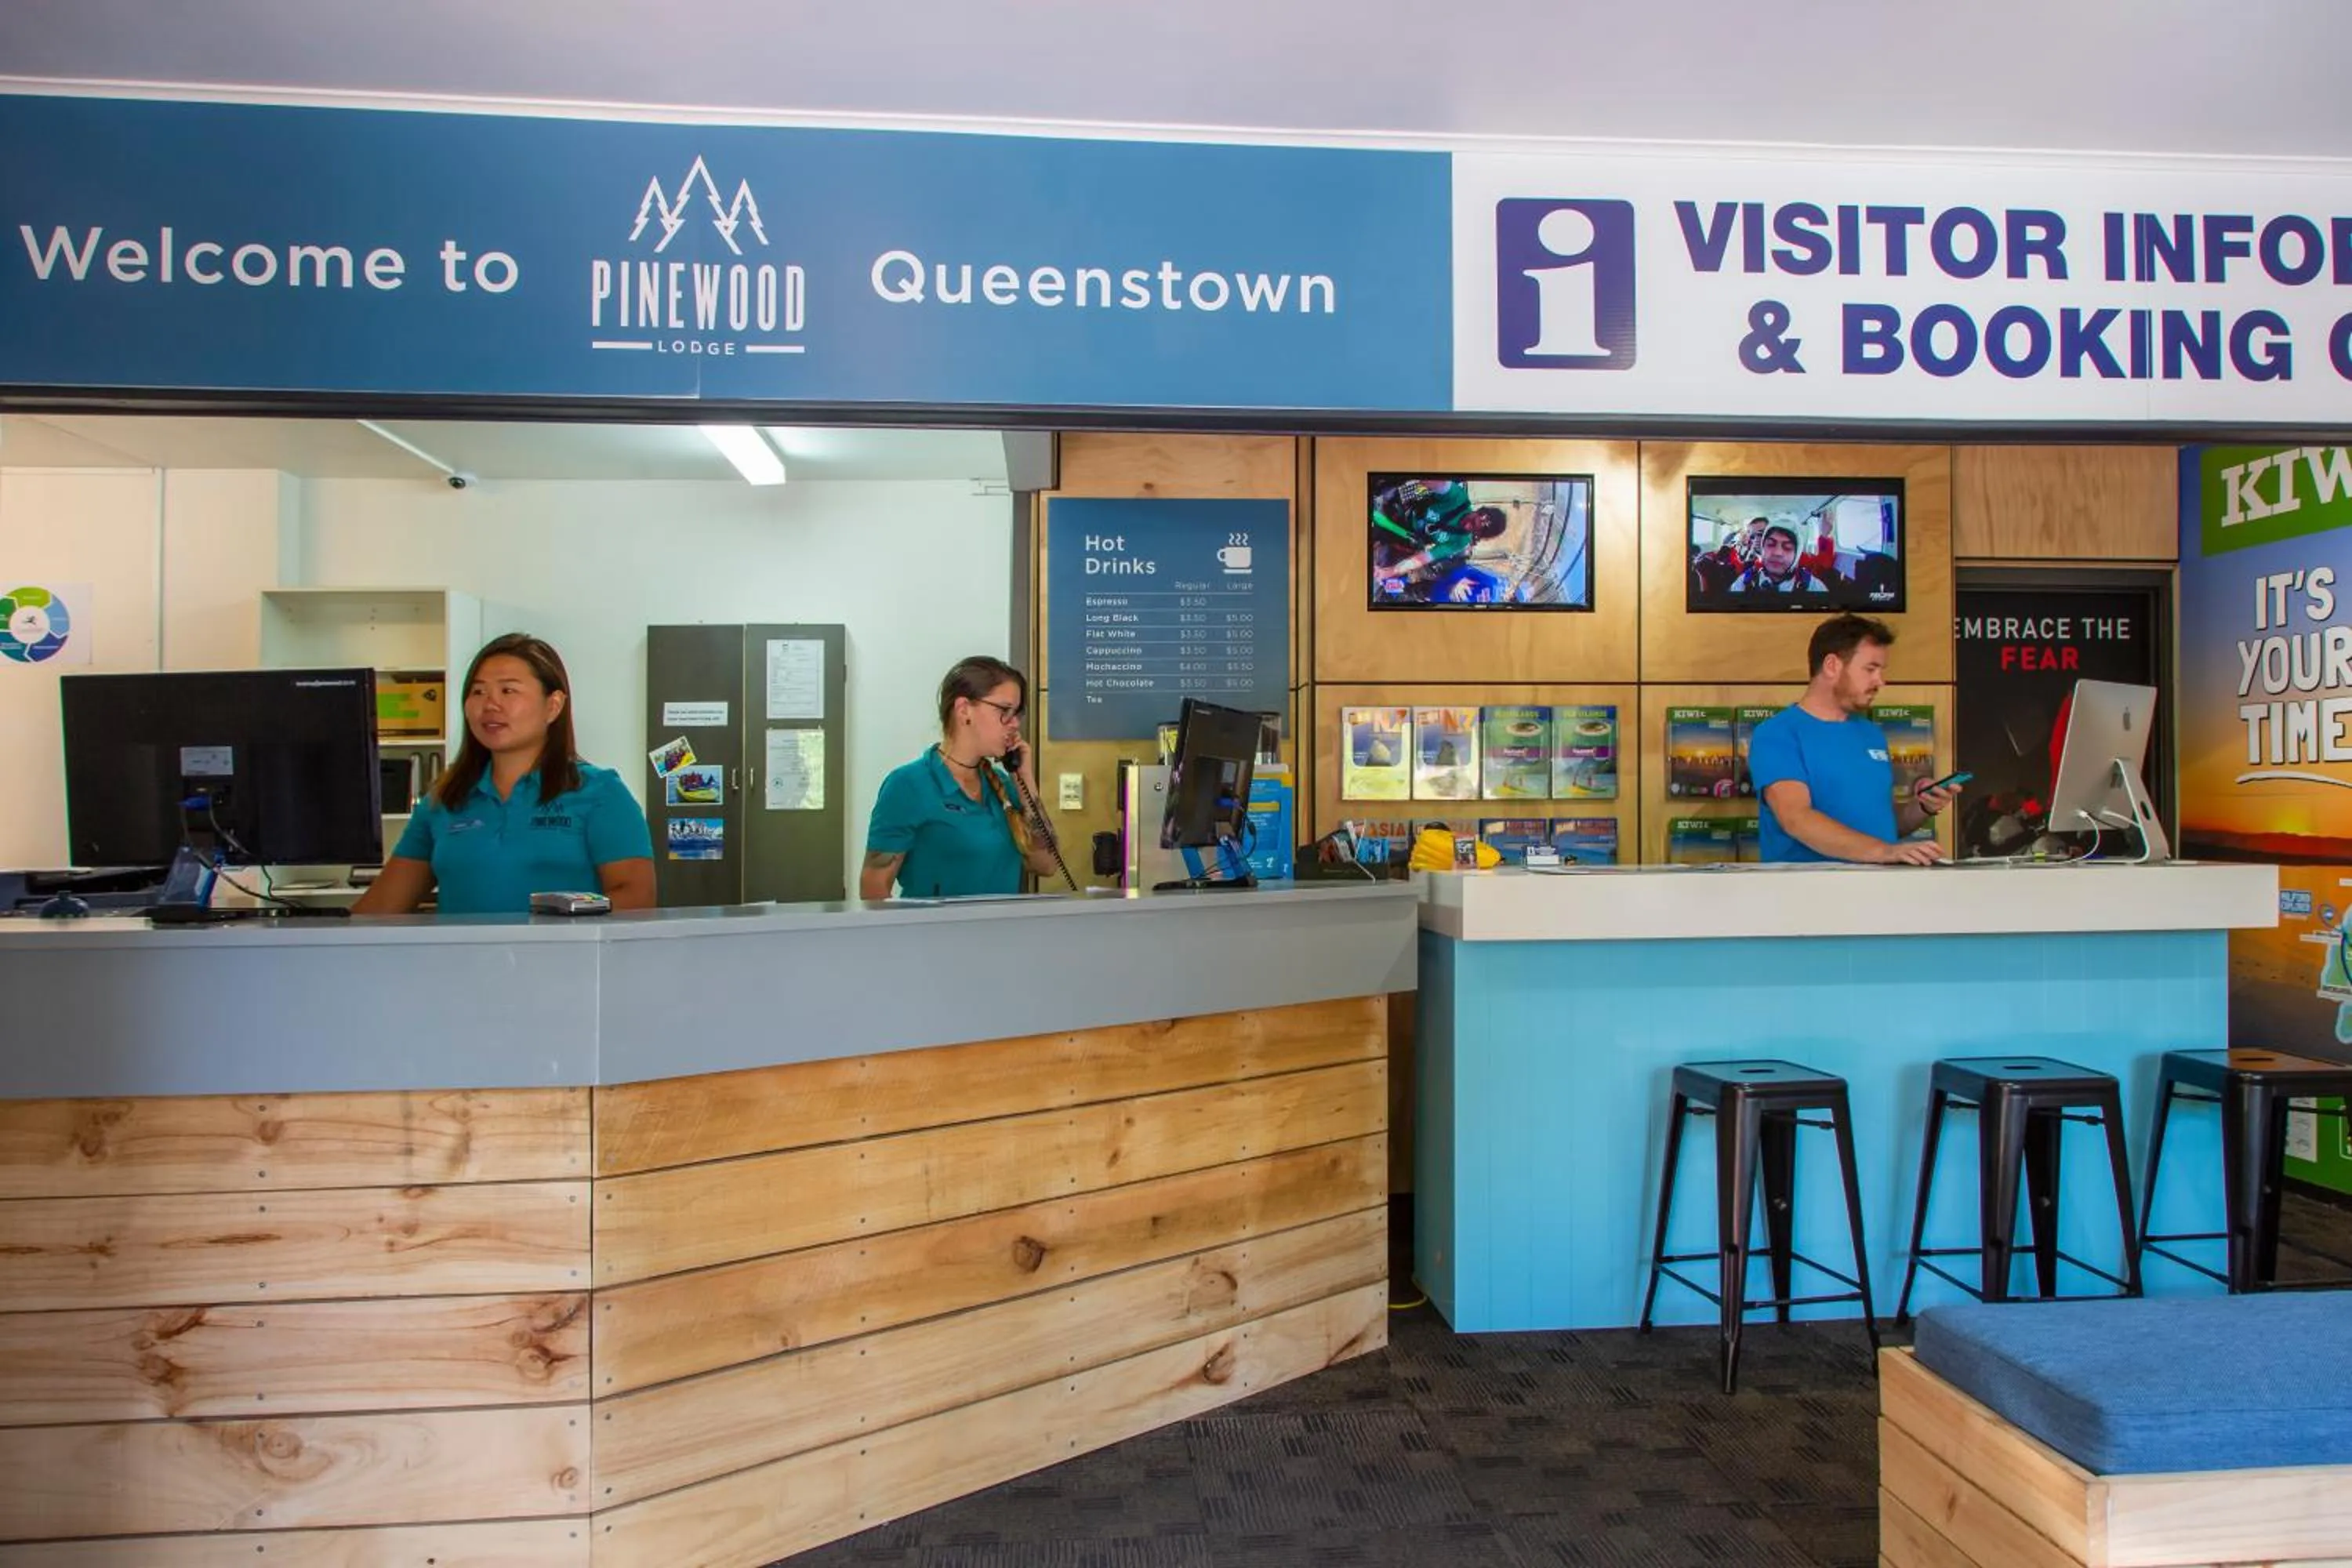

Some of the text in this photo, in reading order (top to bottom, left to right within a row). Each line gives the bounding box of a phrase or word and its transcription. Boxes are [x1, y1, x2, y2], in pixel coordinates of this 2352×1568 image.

[1673, 201, 2069, 280] VISITOR
[20, 225, 518, 292] Welcome to
[871, 250, 1334, 313] Queenstown
[592, 260, 805, 332] PINEWOOD
[658, 340, 735, 355] LODGE
[1738, 299, 1806, 375] &
[1842, 303, 2293, 382] BOOKING
[1085, 535, 1125, 551] Hot
[1085, 557, 1156, 575] Drinks
[1174, 581, 1210, 590] Regular
[1086, 597, 1128, 606] Espresso
[2255, 566, 2336, 630] IT'S
[1086, 614, 1109, 623] Long
[2082, 617, 2131, 639] THE
[1086, 630, 1105, 638] Flat
[1108, 630, 1136, 638] White
[1086, 646, 1142, 655] Cappuccino
[2001, 647, 2080, 670] FEAR
[2237, 625, 2352, 696] YOUR
[1086, 679, 1103, 688] Hot
[1106, 679, 1154, 688] Chocolate
[2239, 697, 2352, 764] TIME
[1368, 822, 1406, 837] ASIA
